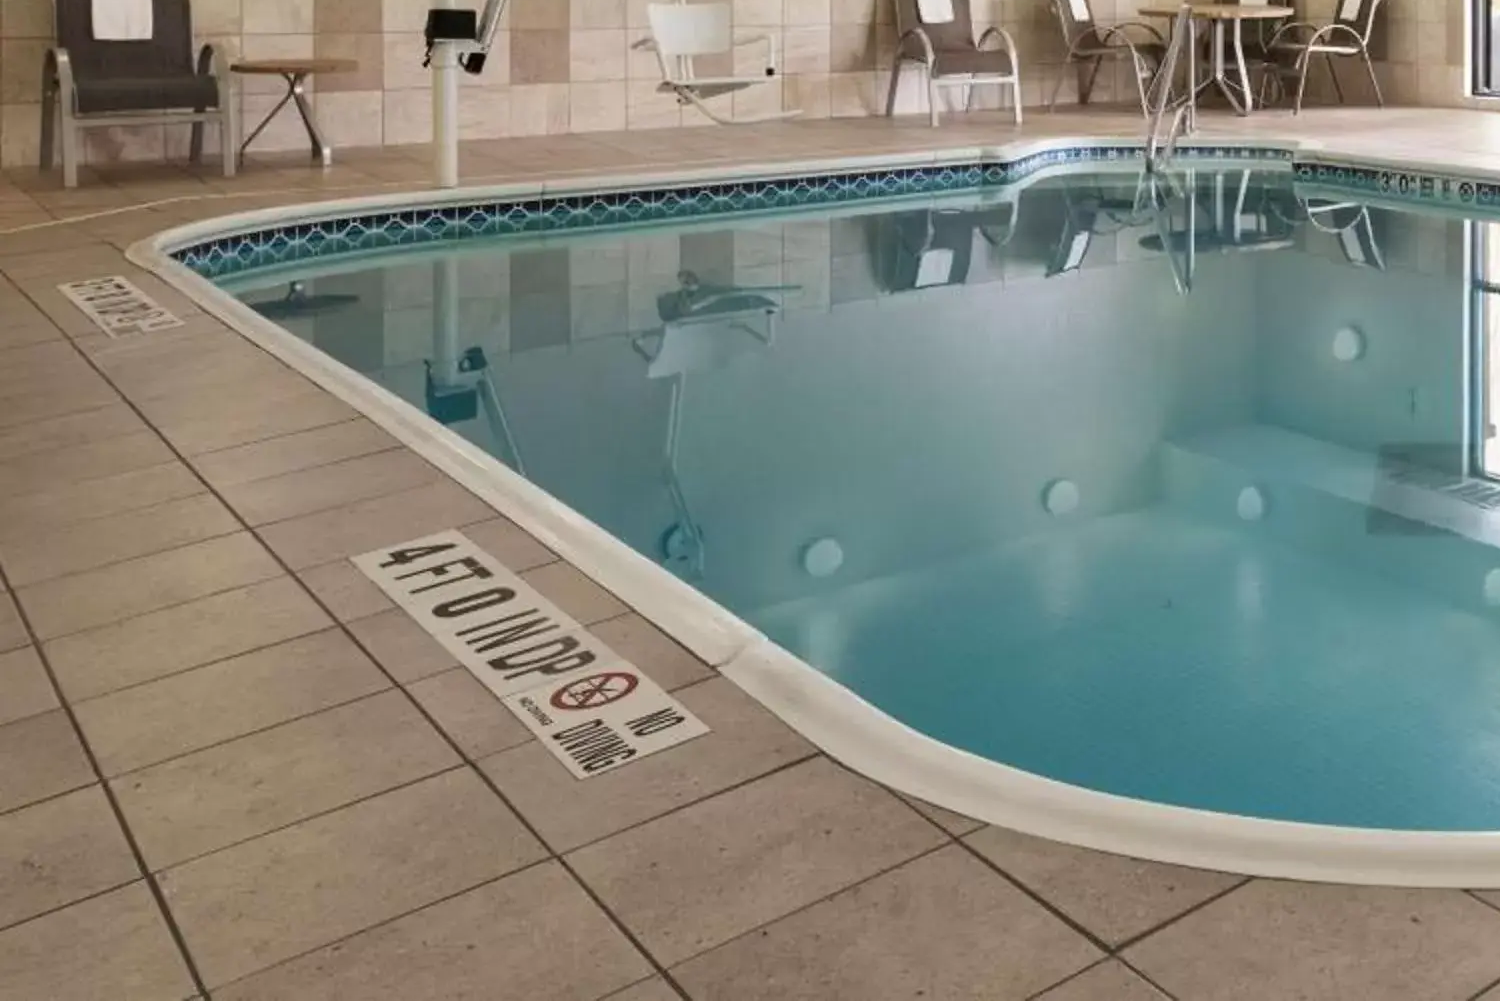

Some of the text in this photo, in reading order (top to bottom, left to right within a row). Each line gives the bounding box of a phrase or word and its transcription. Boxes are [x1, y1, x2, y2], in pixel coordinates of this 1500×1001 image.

[379, 543, 596, 681] 4 FT 0 IN DP
[551, 718, 637, 773] DIVING
[625, 706, 685, 737] NO
